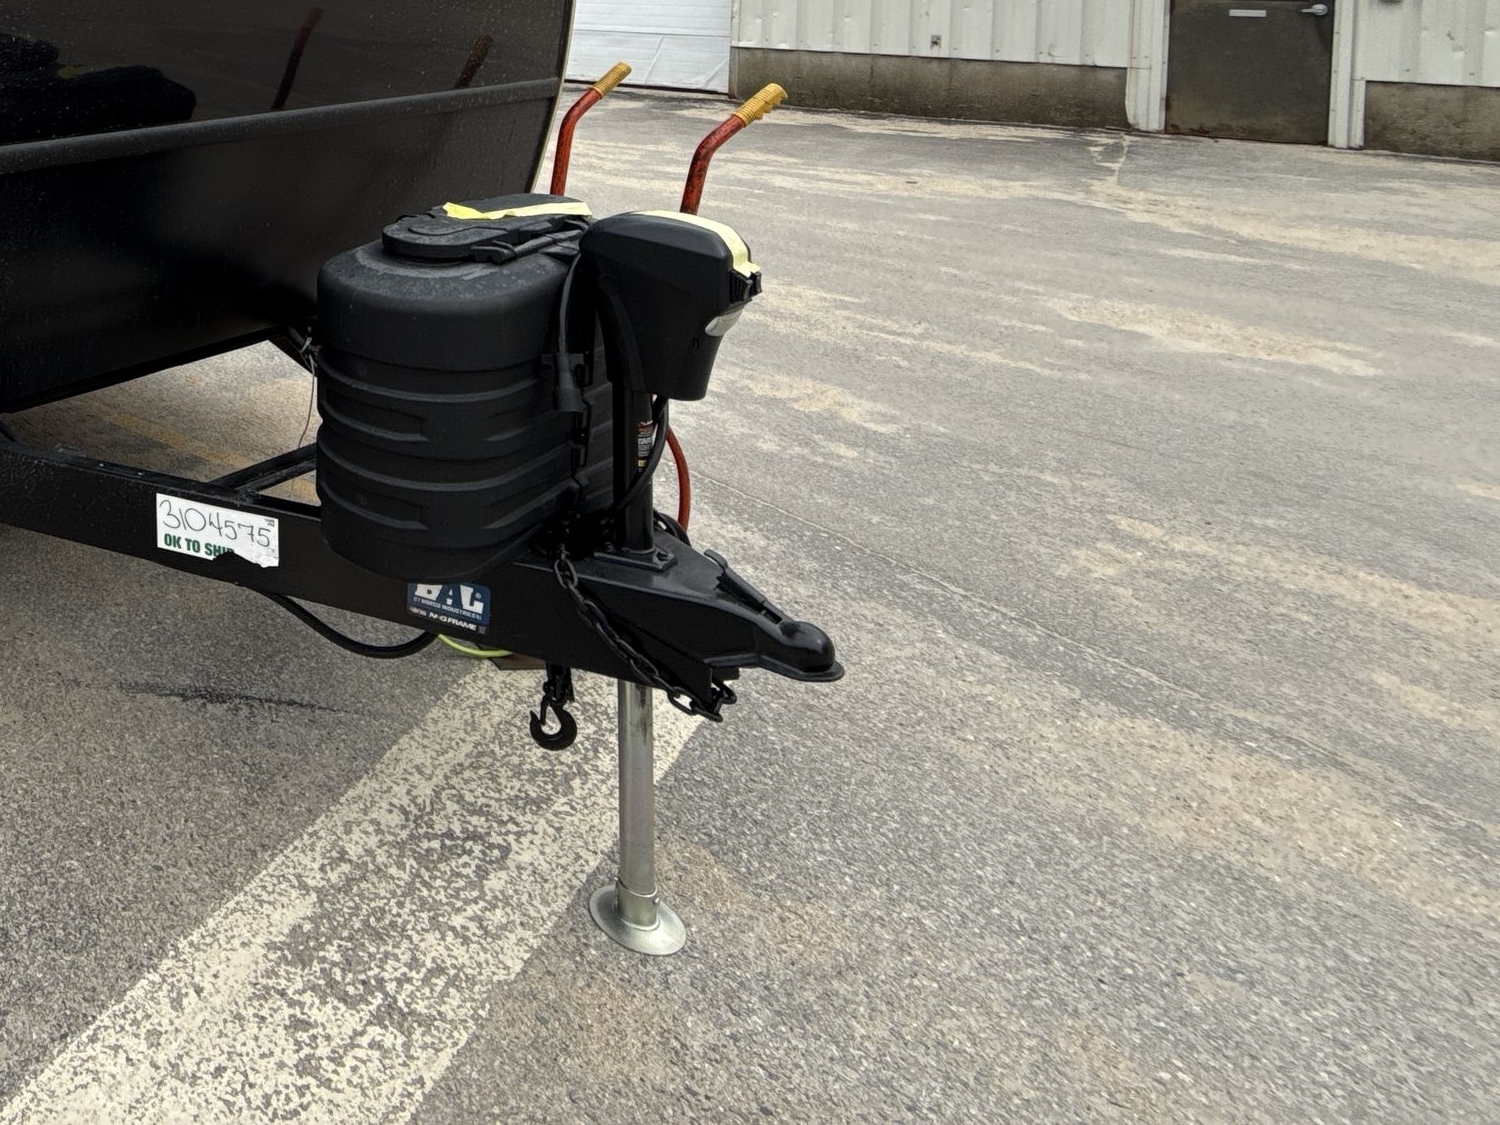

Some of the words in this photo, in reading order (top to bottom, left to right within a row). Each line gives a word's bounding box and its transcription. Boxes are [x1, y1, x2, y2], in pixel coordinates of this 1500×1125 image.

[159, 499, 272, 548] 3104575
[164, 533, 182, 550] OK
[184, 538, 201, 554] TO
[447, 617, 477, 632] FRAME
